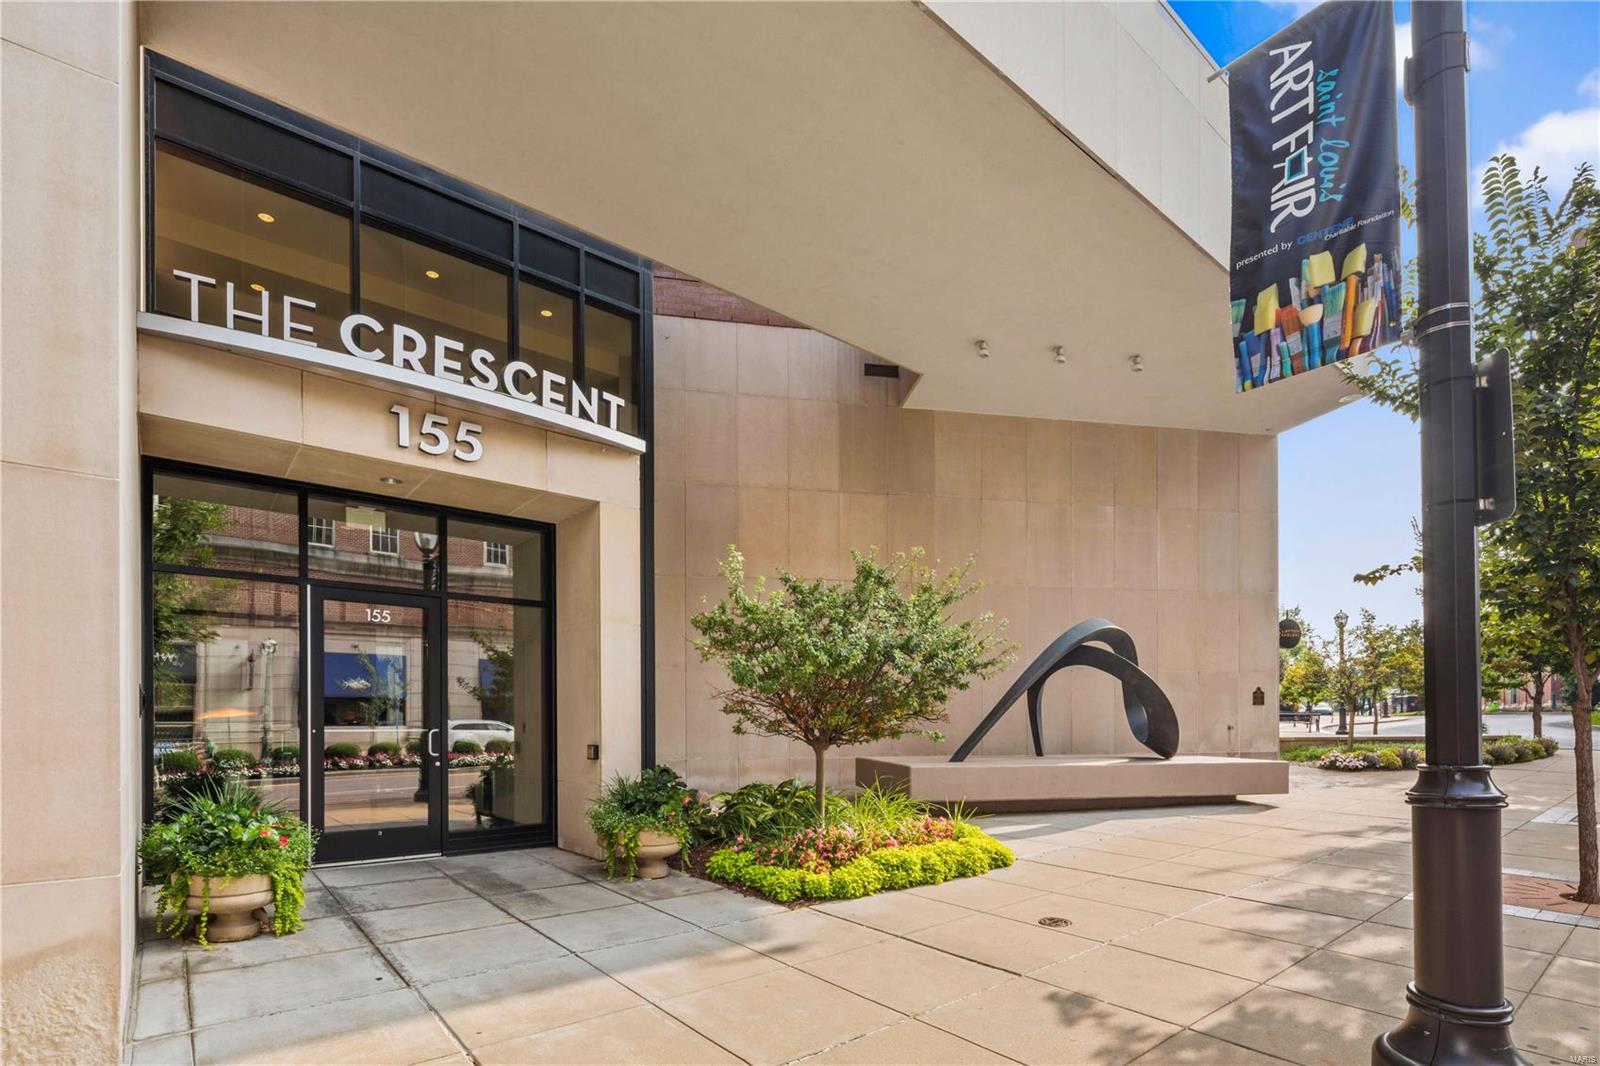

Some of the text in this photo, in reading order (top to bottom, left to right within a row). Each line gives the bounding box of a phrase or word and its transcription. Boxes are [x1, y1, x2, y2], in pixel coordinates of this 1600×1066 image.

[1269, 40, 1317, 234] ART FAIR
[1316, 68, 1350, 202] saint louis
[1357, 209, 1395, 228] Foundation
[1235, 243, 1279, 270] presented
[1281, 240, 1293, 250] by
[173, 269, 626, 431] THE CRESCENT
[390, 405, 484, 463] 155
[365, 608, 392, 623] 155
